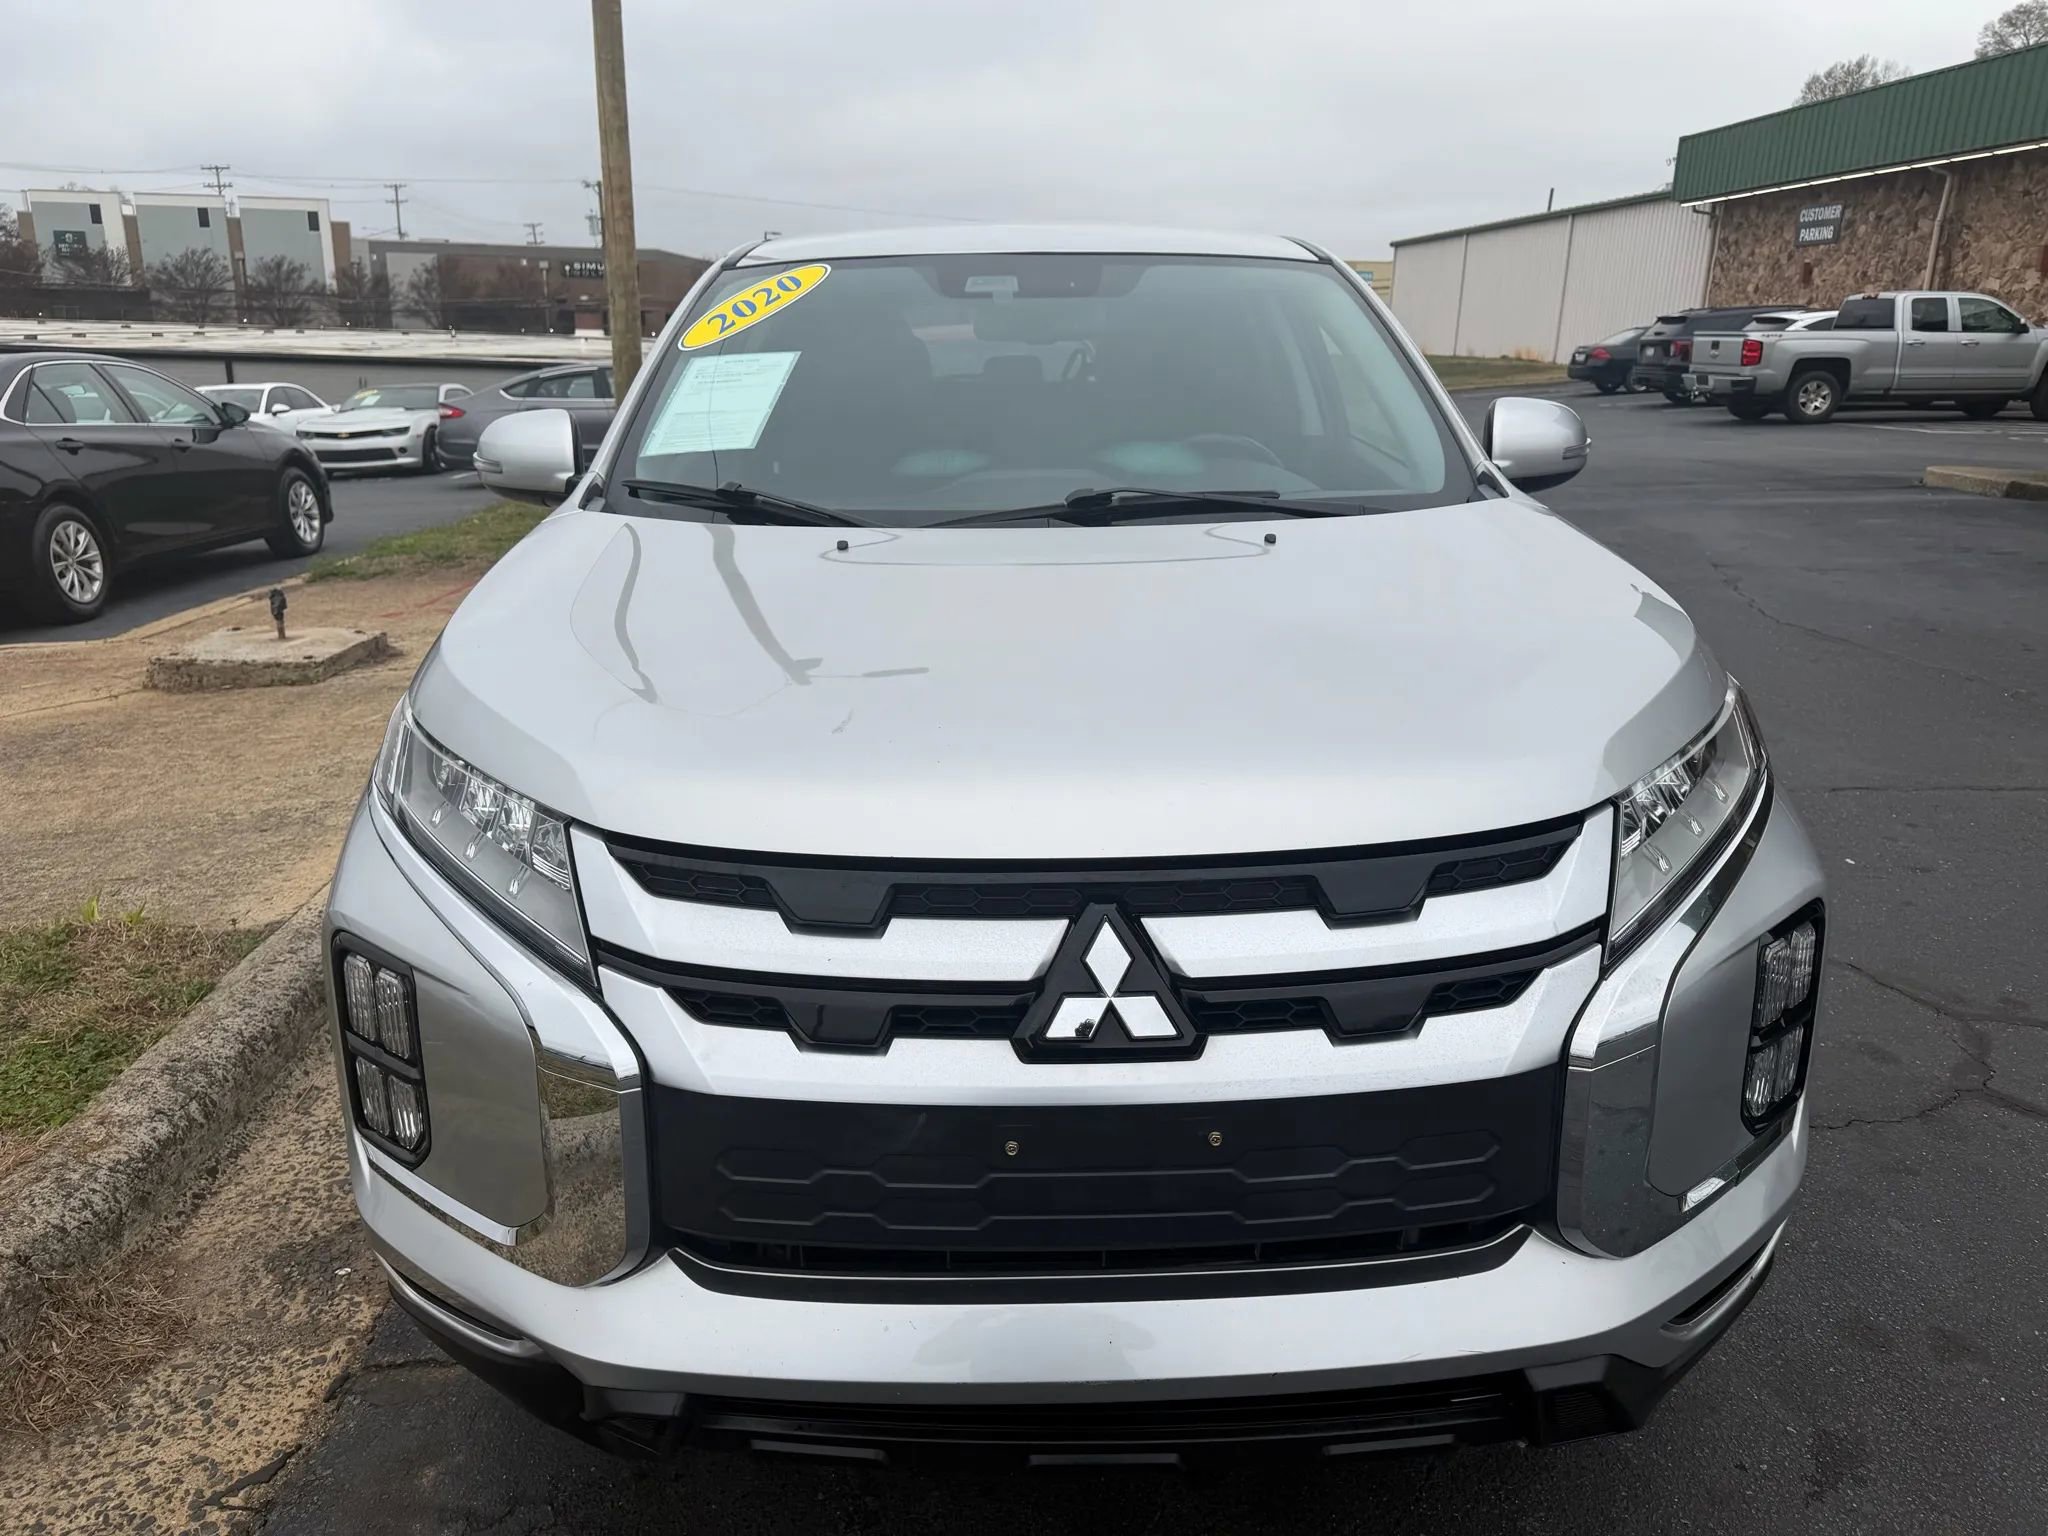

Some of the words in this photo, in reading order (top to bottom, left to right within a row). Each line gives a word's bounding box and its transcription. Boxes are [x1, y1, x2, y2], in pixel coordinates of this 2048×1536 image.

[1800, 204, 1842, 222] CUSTOMER
[1799, 225, 1834, 242] PARKING
[707, 275, 802, 335] 2020
